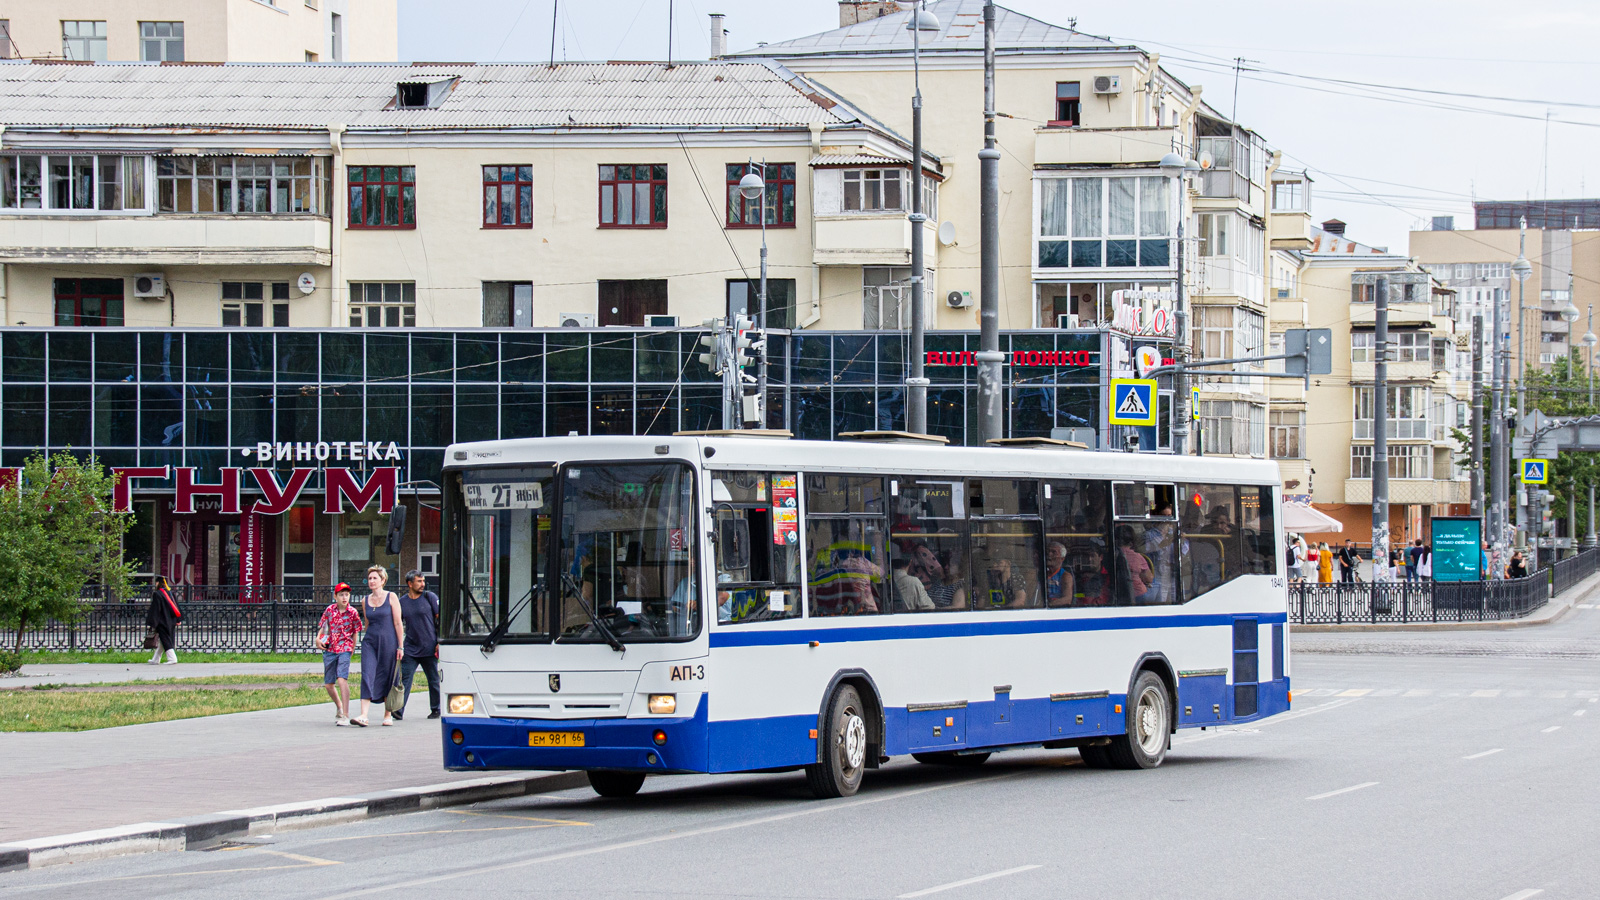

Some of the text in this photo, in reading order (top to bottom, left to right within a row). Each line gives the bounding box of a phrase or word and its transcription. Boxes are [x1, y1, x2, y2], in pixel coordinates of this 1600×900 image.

[257, 441, 401, 461] ВИНОТЕКА
[491, 484, 540, 508] 27 ЖБИ
[1271, 577, 1284, 588] 1840
[670, 664, 705, 681] АП-3
[549, 733, 567, 745] 981
[571, 732, 582, 742] 66
